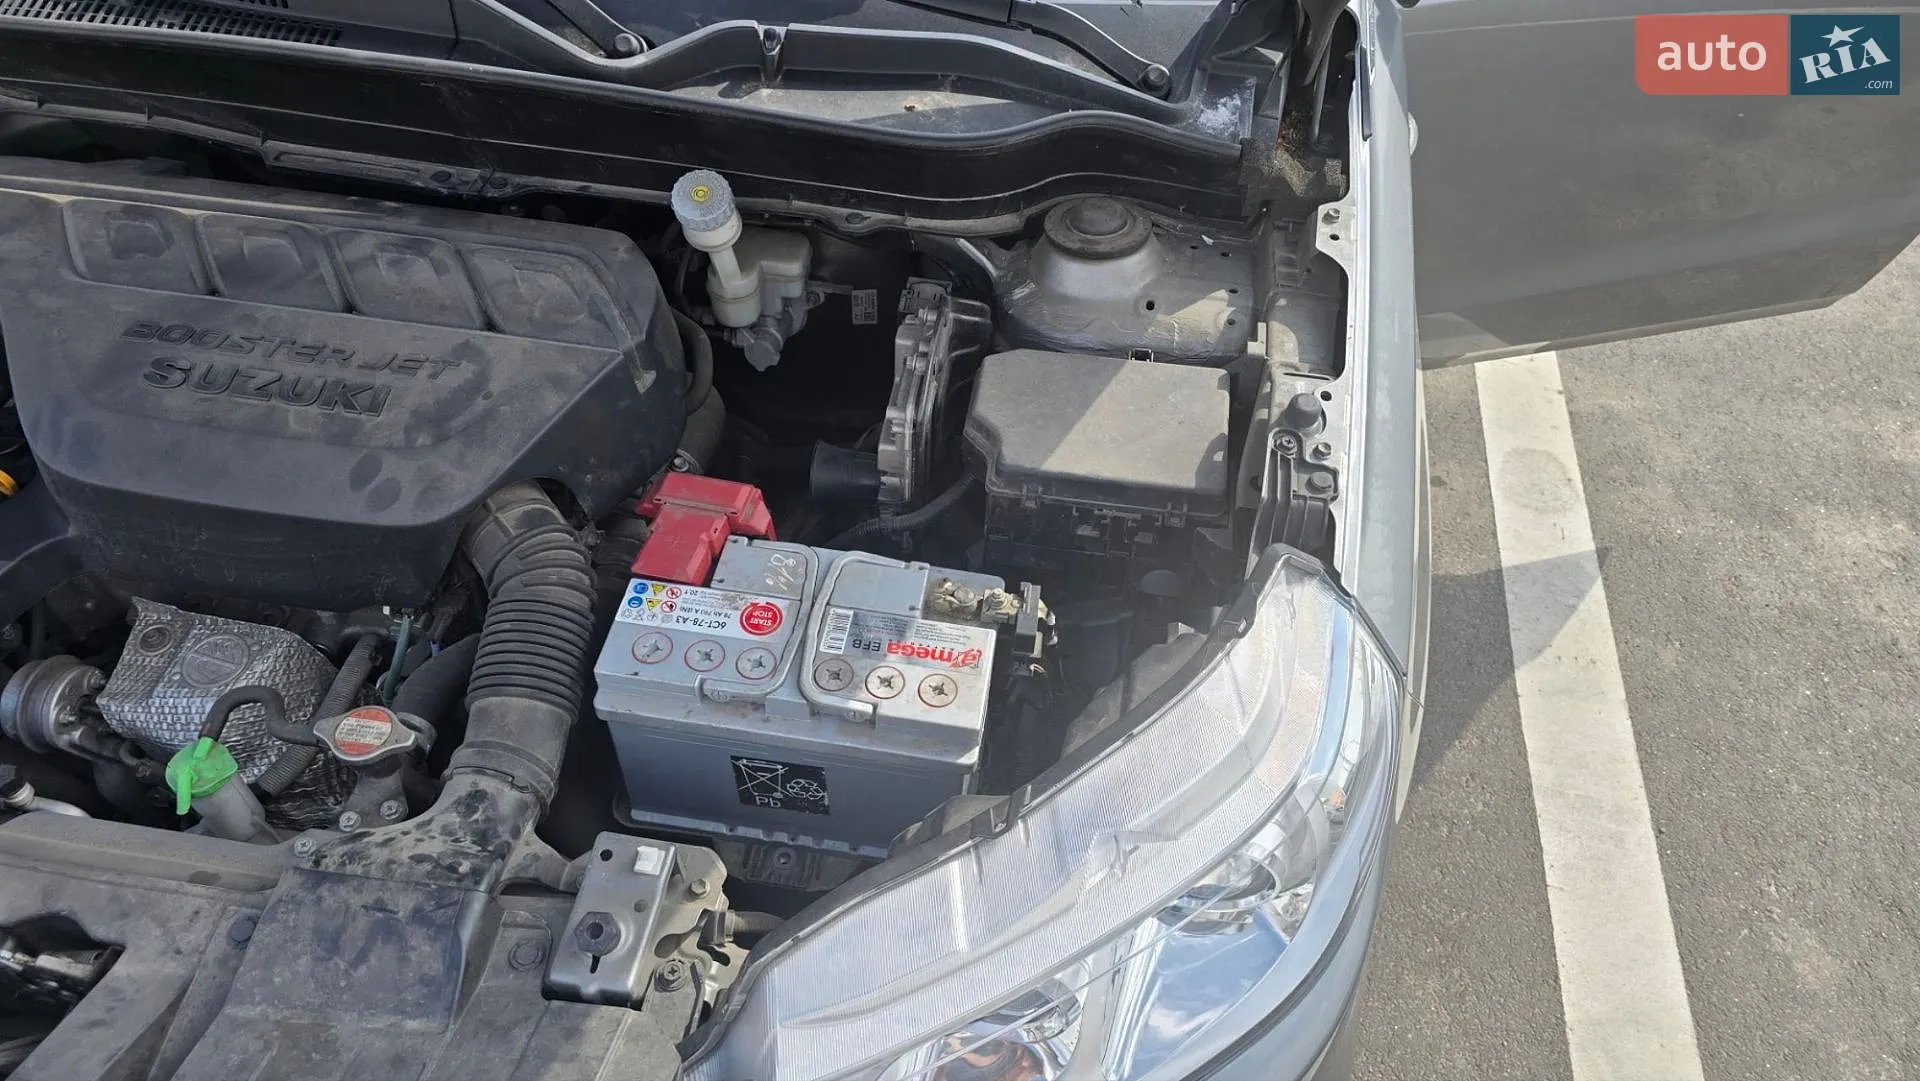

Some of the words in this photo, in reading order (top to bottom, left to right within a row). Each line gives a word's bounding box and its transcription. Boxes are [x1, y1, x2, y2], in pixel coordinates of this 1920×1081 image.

[143, 356, 392, 418] SUZUKI
[752, 610, 773, 618] STOP
[675, 615, 727, 629] 6CT-78-A3
[750, 616, 772, 626] START
[852, 639, 881, 652] EFB
[755, 796, 781, 808] Pb
